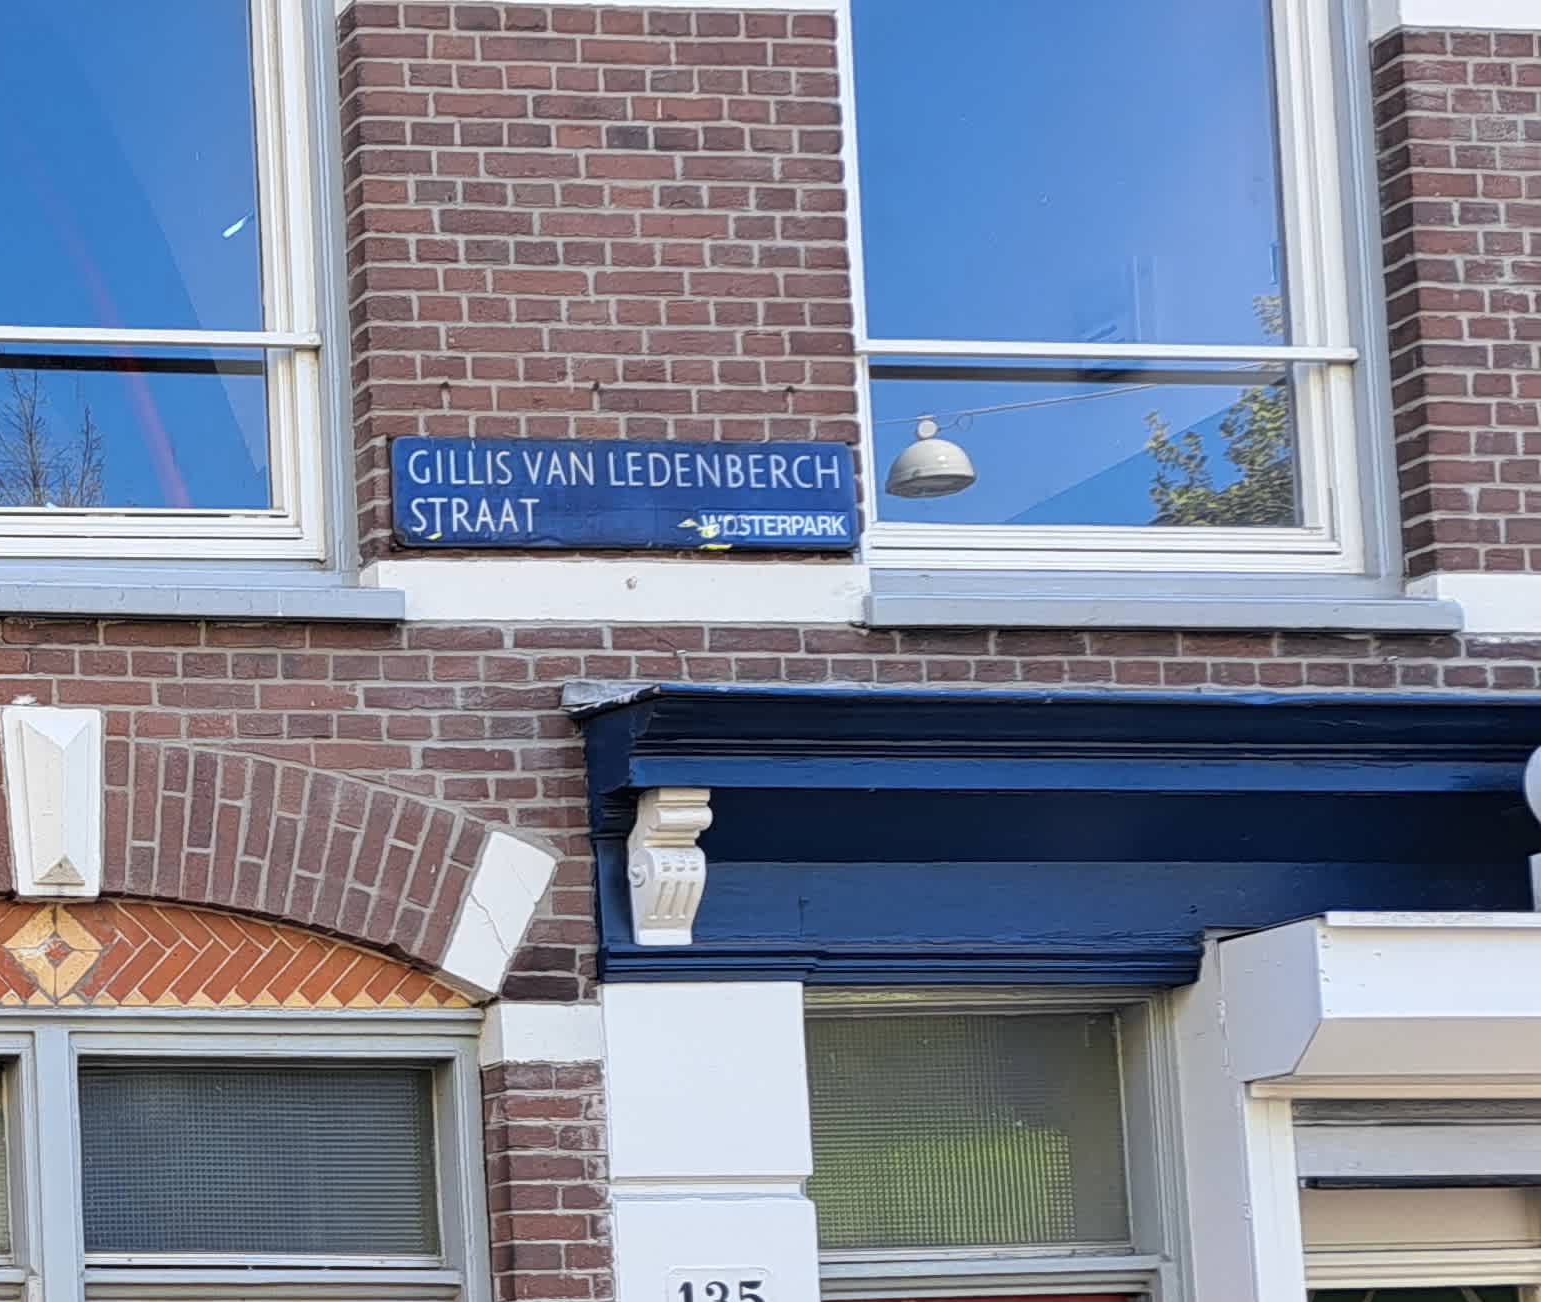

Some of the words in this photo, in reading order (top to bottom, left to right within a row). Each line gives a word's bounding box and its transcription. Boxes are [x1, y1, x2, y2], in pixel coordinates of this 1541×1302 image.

[408, 449, 513, 485] GILLIS
[523, 452, 594, 485] VAN
[608, 453, 840, 488] LEDENBERCH
[410, 497, 540, 533] STRAAT
